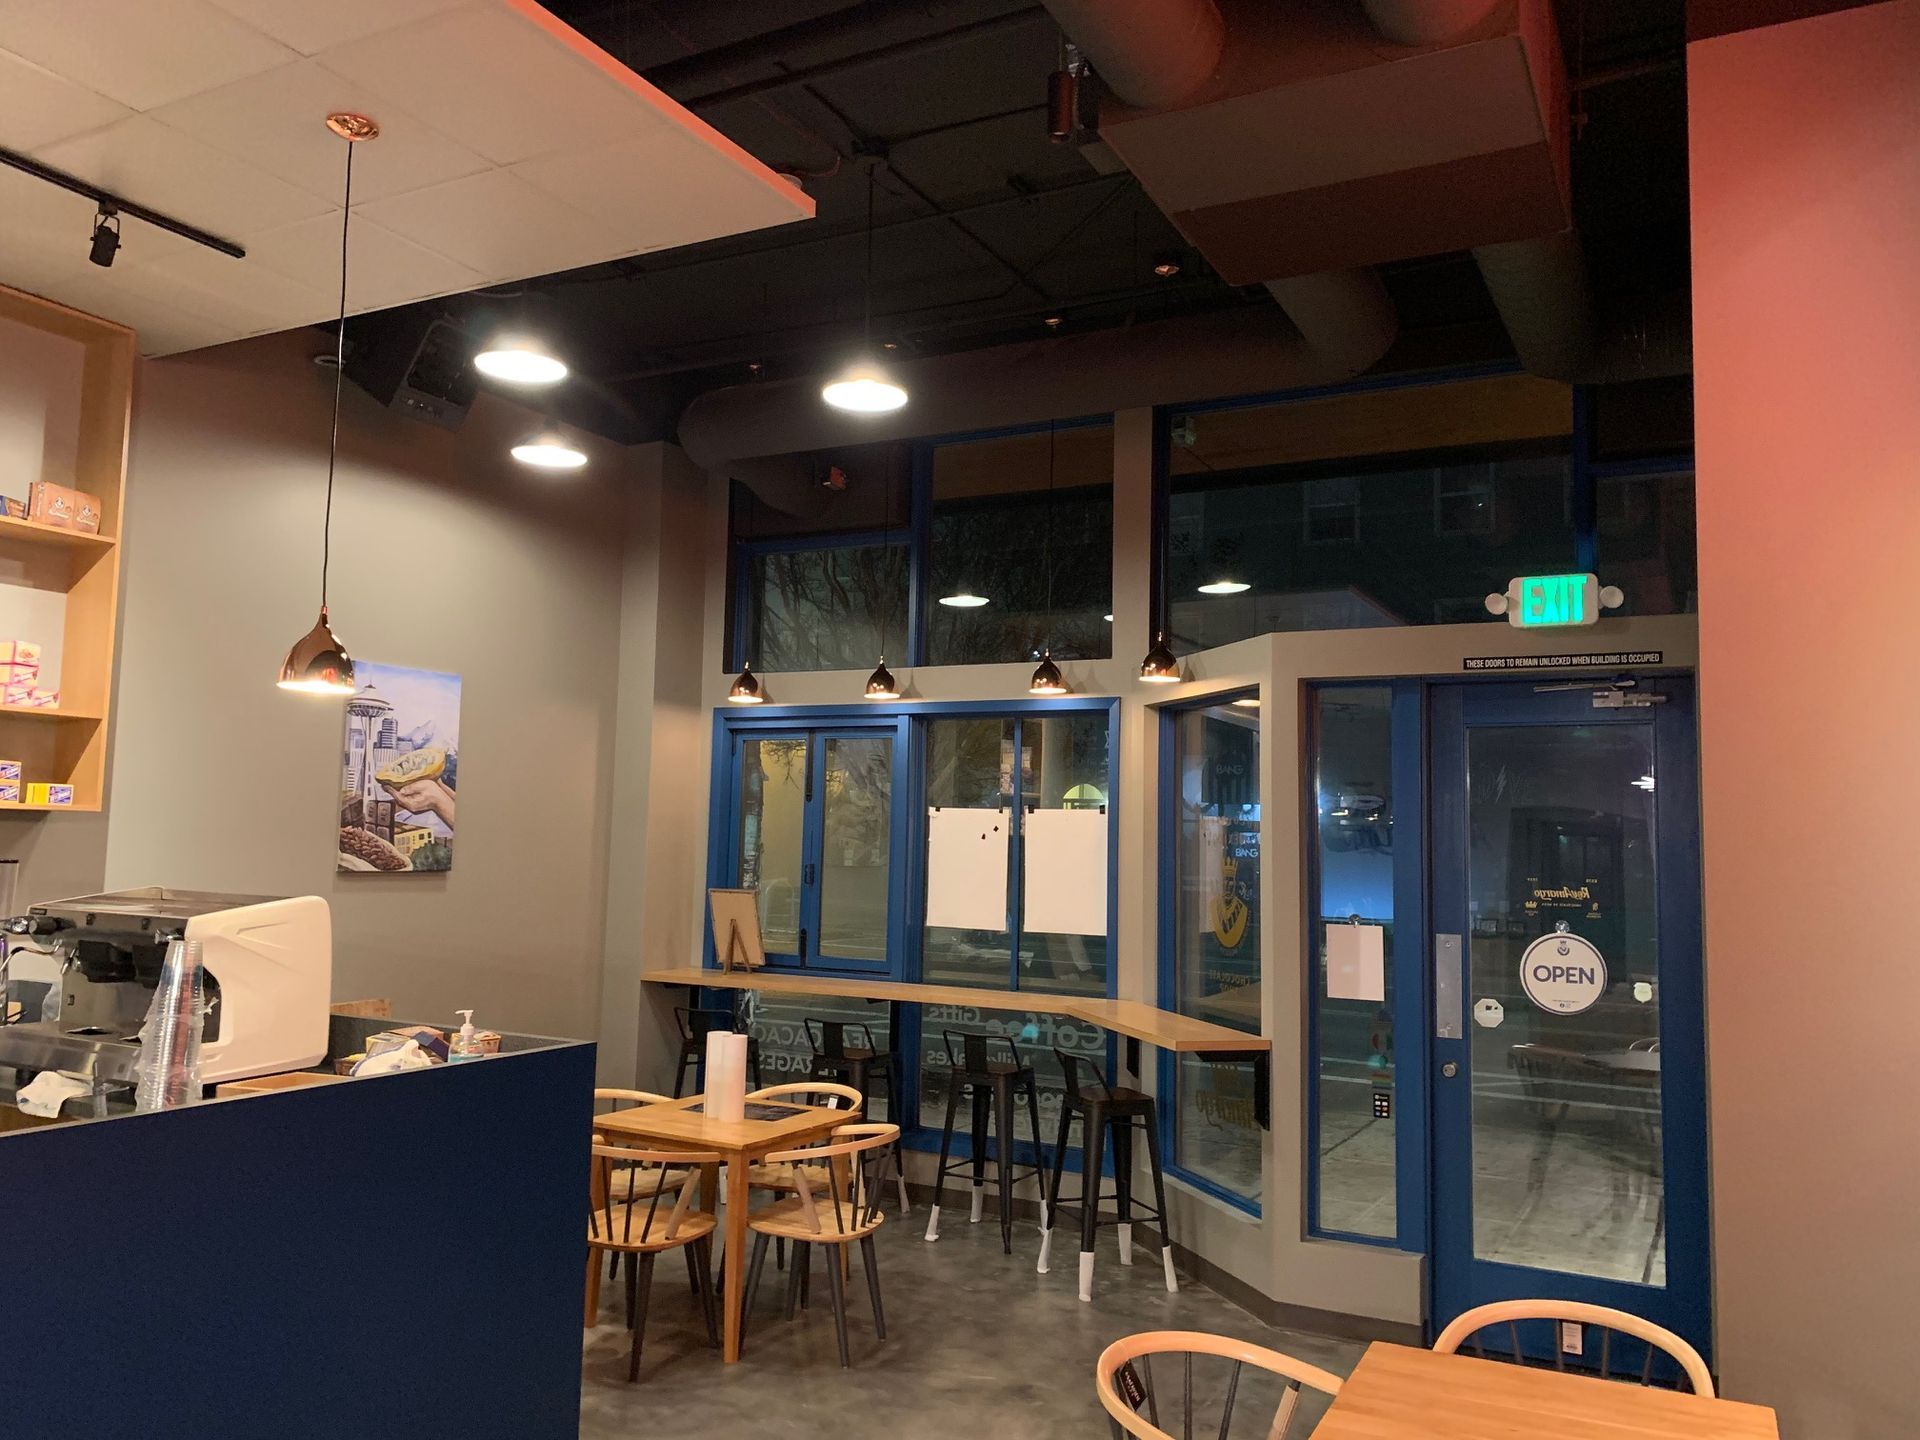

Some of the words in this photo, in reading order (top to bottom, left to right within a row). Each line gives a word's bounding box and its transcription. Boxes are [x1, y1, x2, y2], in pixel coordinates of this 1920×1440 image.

[1522, 575, 1588, 624] EXIT
[1466, 659, 1484, 668] THESE
[1484, 658, 1506, 667] DOORS
[1506, 658, 1514, 667] TO
[1515, 657, 1539, 667] REMAIN
[1539, 656, 1571, 666] UNLOCKED
[1571, 655, 1590, 665] WHEN
[1591, 654, 1620, 664] BUILDING
[1621, 654, 1628, 663] IS
[1628, 653, 1660, 663] OCCUPIED
[1235, 848, 1258, 858] BANG
[1533, 965, 1595, 985] OPEN
